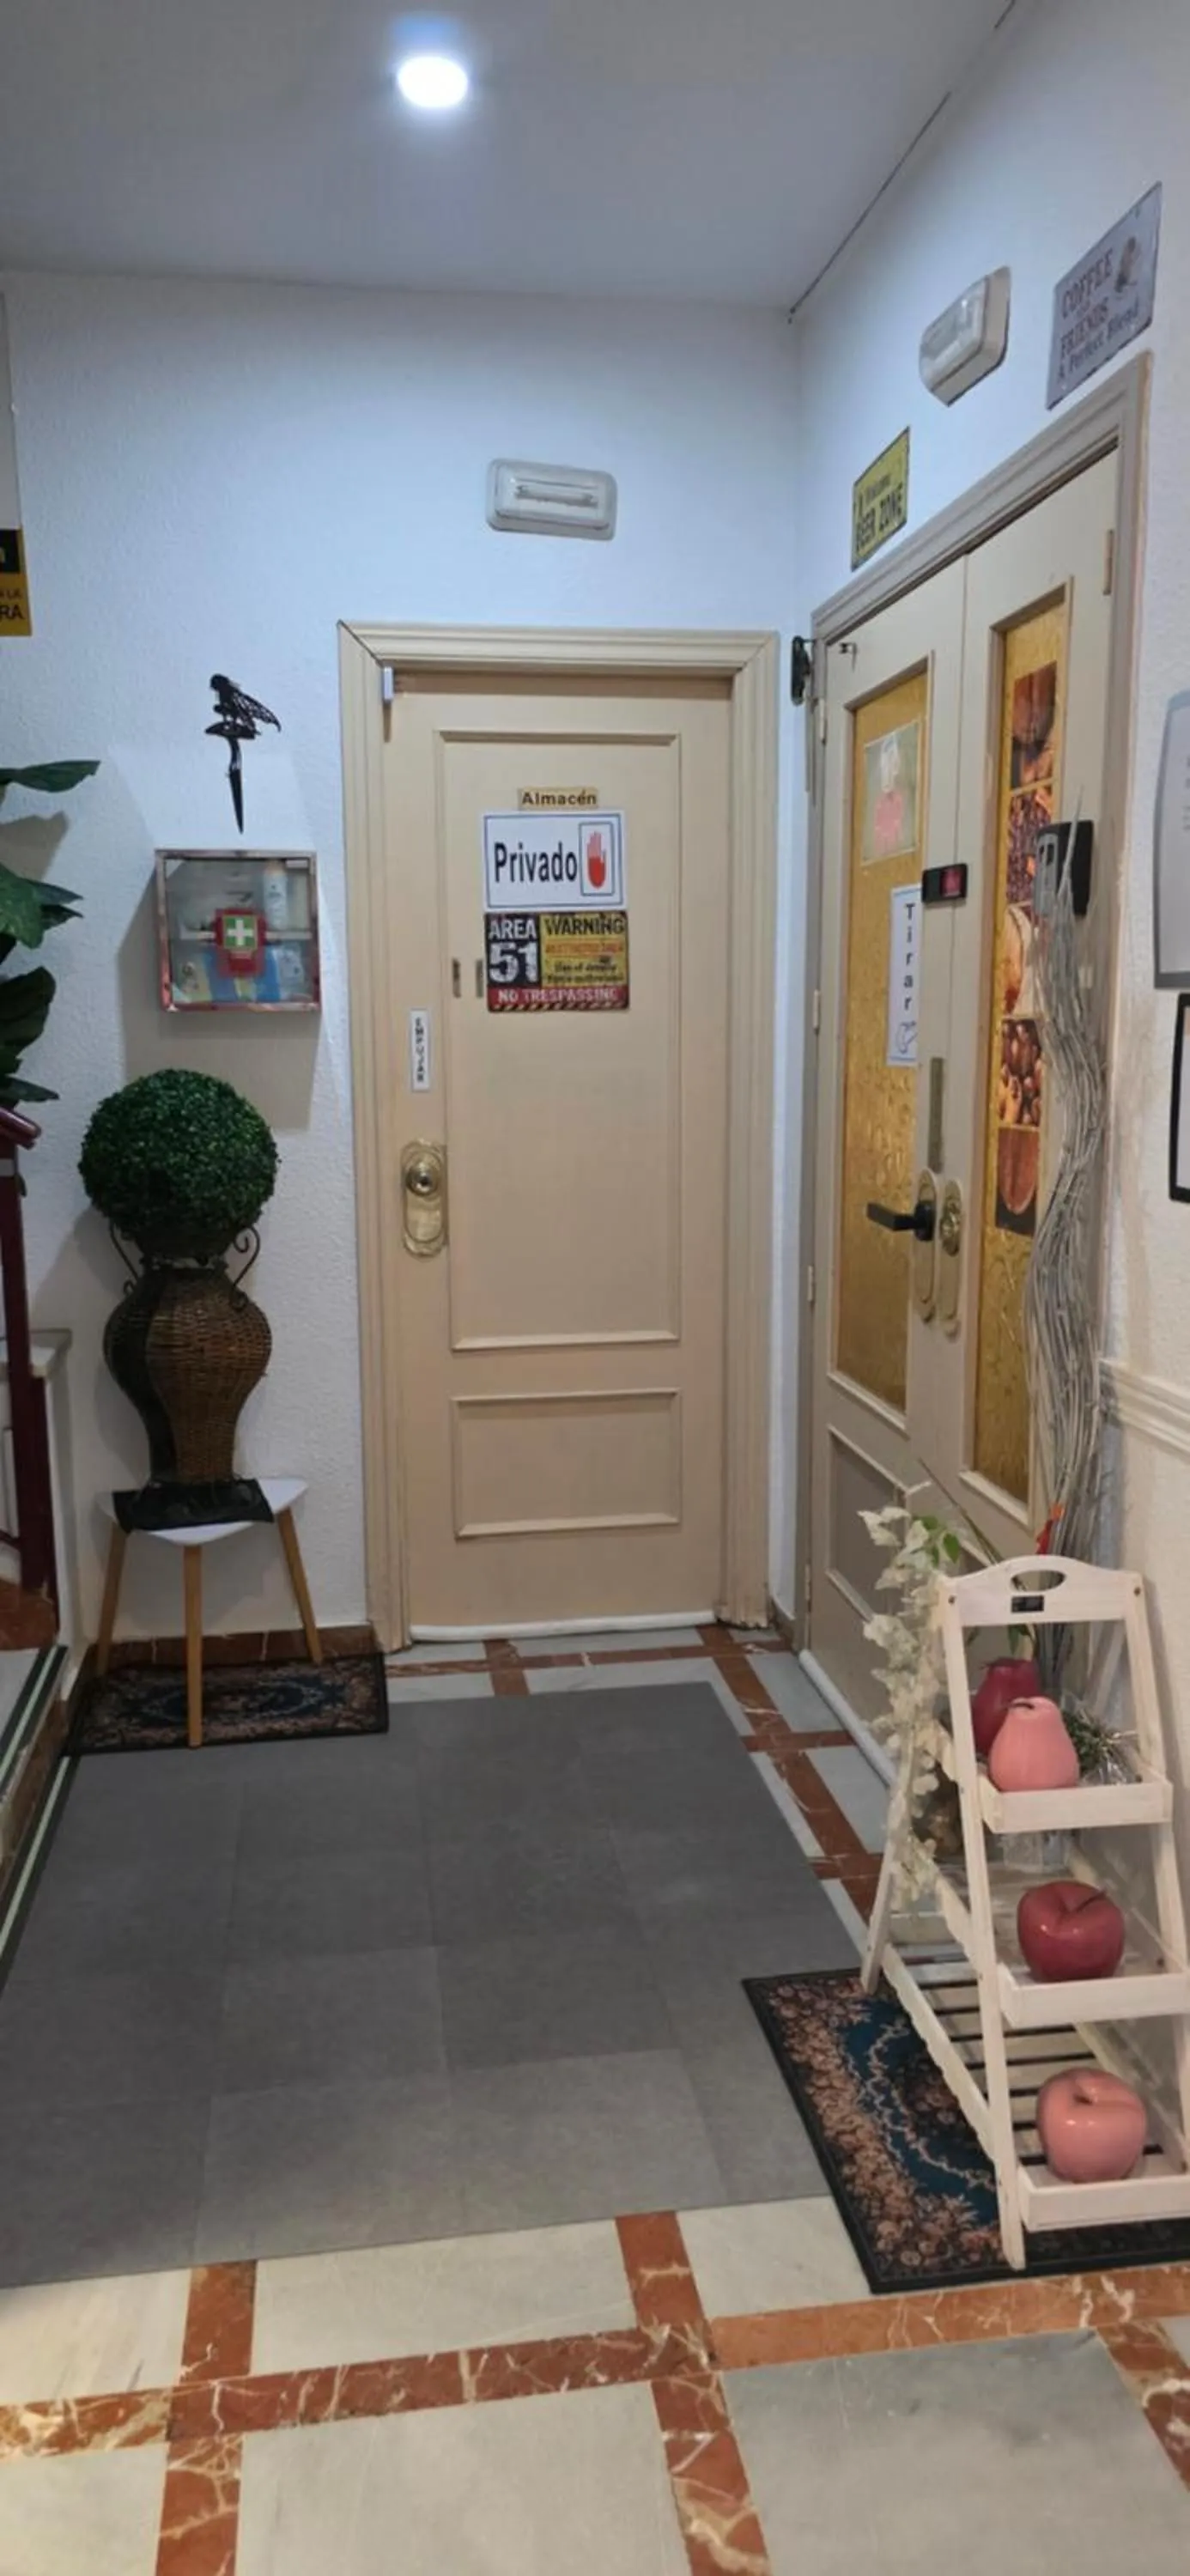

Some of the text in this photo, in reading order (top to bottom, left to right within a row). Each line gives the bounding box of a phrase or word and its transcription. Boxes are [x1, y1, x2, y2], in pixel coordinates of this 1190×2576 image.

[1062, 247, 1114, 319] COFFEE
[522, 789, 597, 805] Almacén
[494, 841, 578, 883] Privado
[489, 919, 537, 939] AREA
[544, 917, 625, 935] WARNING
[489, 941, 538, 983] 51
[904, 903, 915, 1011] Tirar
[498, 987, 618, 1003] NO TRESPASSING
